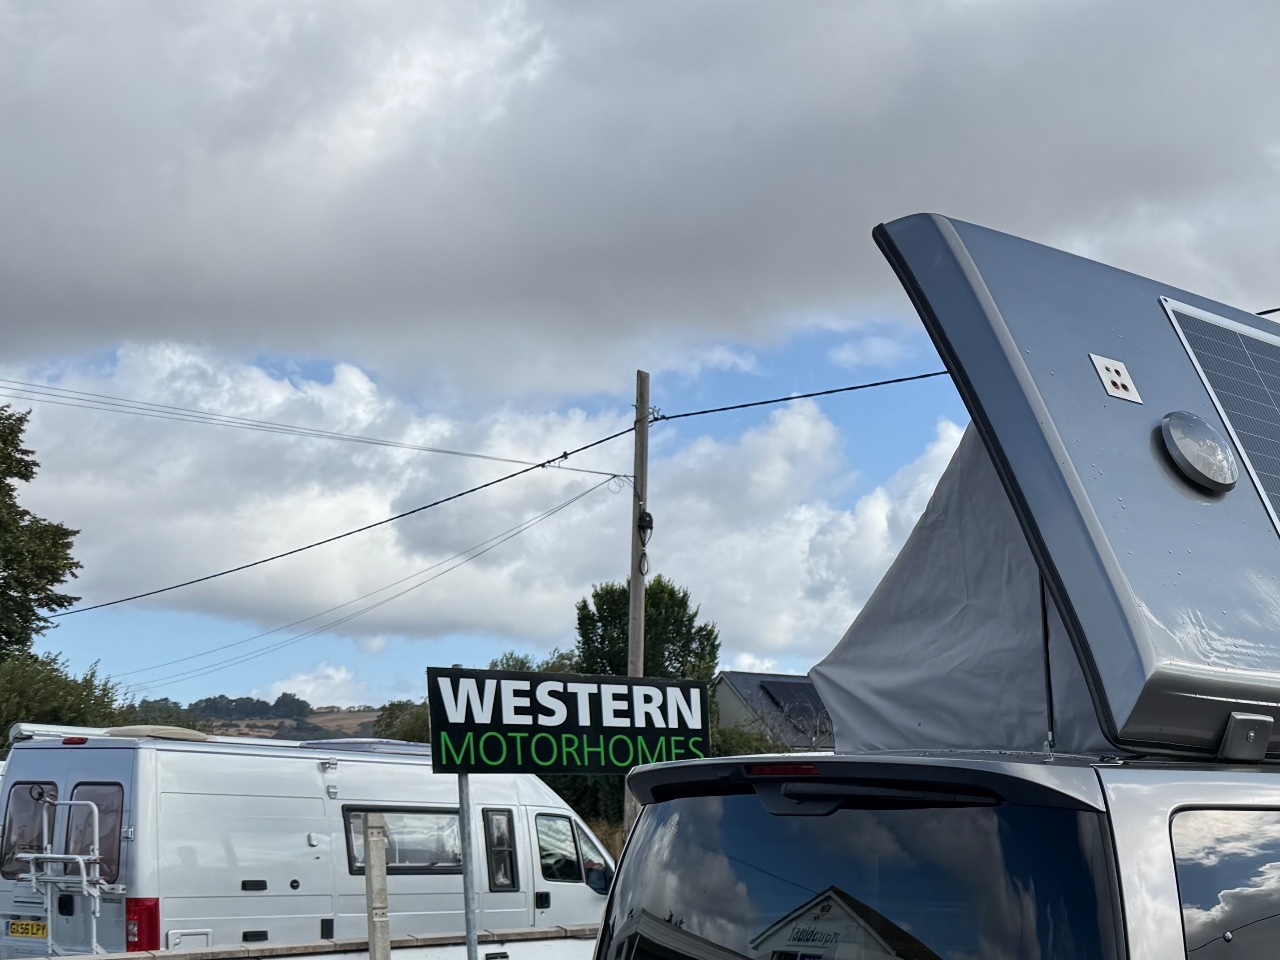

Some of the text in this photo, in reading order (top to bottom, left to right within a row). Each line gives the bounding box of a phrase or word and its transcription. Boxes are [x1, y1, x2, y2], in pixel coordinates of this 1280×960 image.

[437, 677, 702, 730] WESTERN
[440, 731, 705, 766] MOTORHOMES
[10, 922, 46, 936] GX56 LPY
